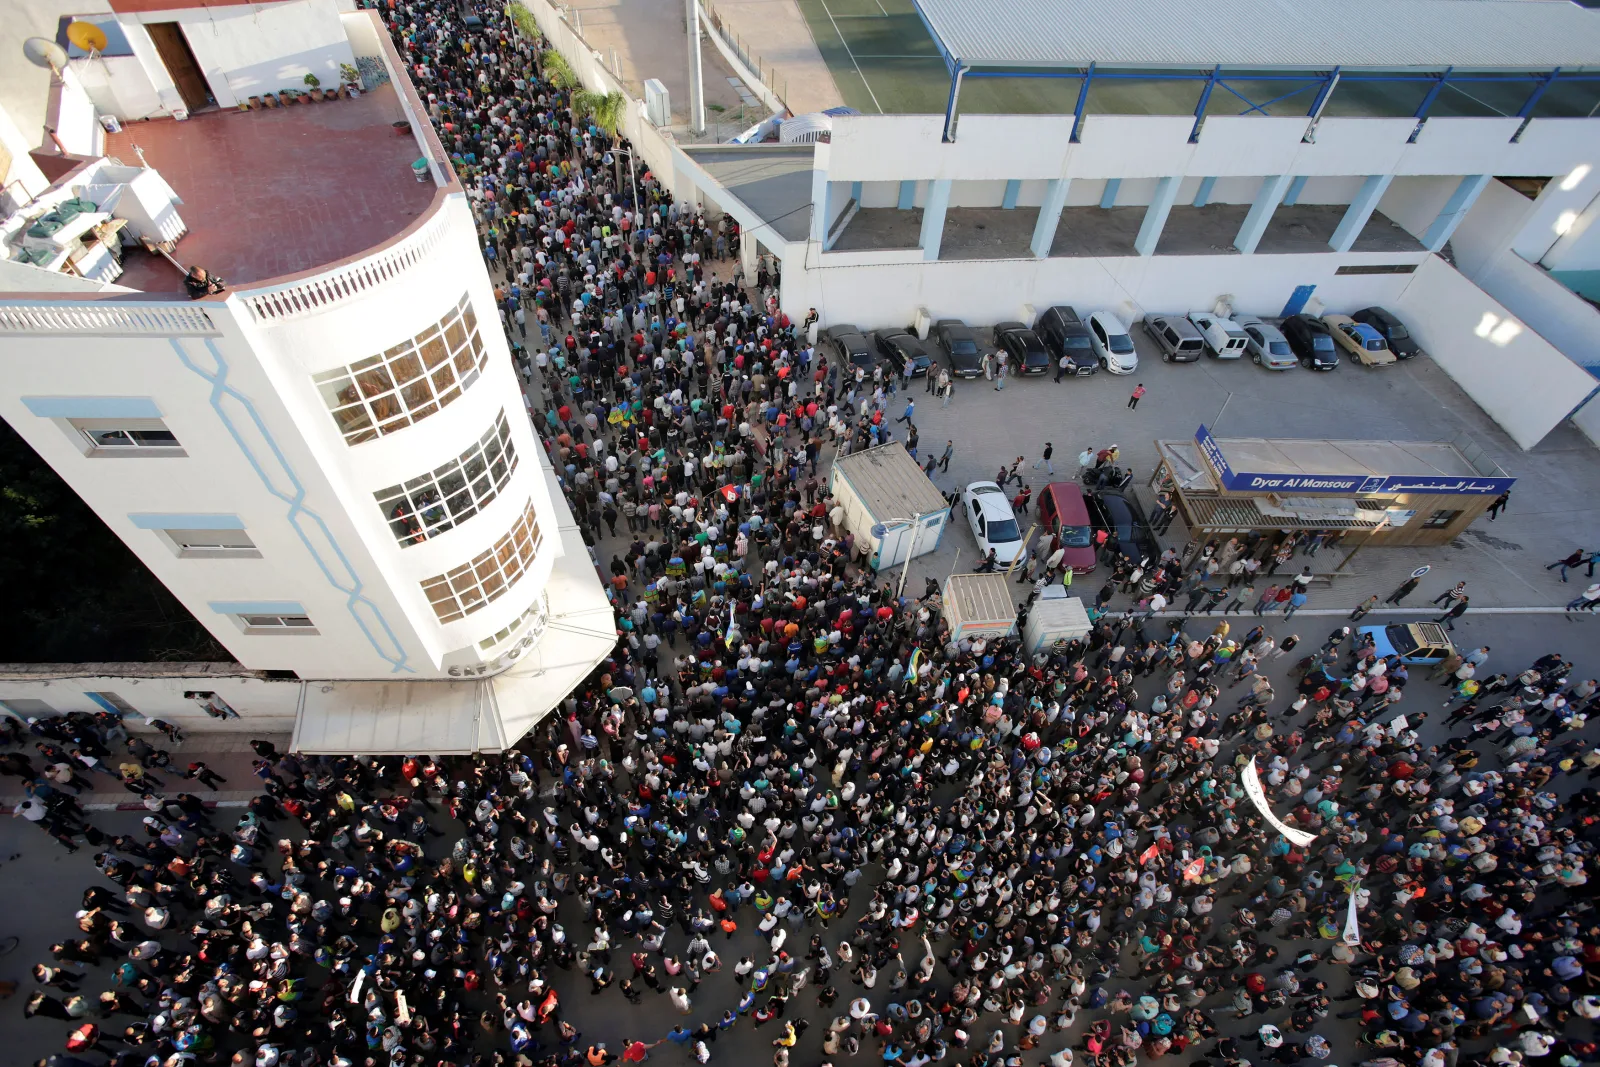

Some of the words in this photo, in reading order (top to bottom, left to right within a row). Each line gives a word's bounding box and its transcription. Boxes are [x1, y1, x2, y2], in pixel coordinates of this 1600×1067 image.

[1250, 477, 1283, 488] Dyar
[1283, 478, 1297, 487] Al
[1299, 479, 1355, 488] Mansour
[1388, 482, 1464, 492] المنصور
[1462, 482, 1495, 492] ديار
